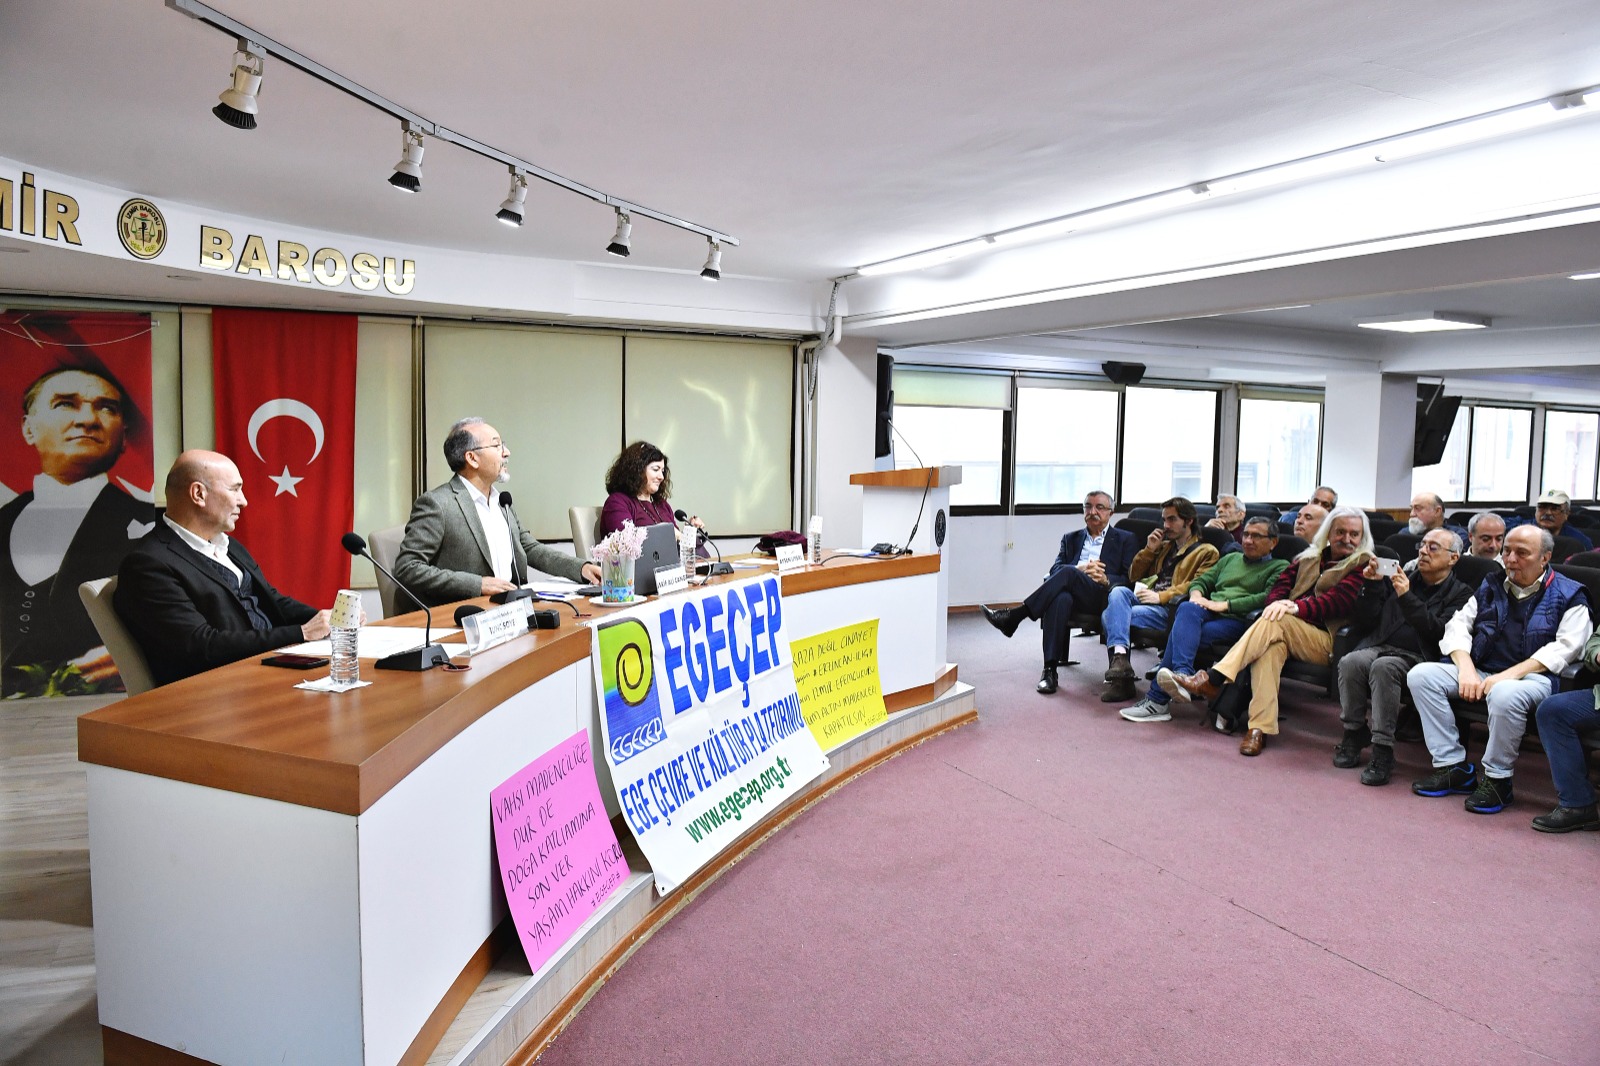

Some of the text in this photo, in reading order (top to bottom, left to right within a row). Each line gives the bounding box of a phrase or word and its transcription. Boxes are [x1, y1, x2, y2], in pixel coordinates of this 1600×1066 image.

[200, 225, 416, 295] BAROSU
[659, 578, 781, 715] EGEÇEP
[620, 691, 804, 836] EGE ÇEVRE VE KÜLTÜR PLATFORMU
[513, 797, 555, 851] DUR DE
[528, 854, 574, 910] SON VER
